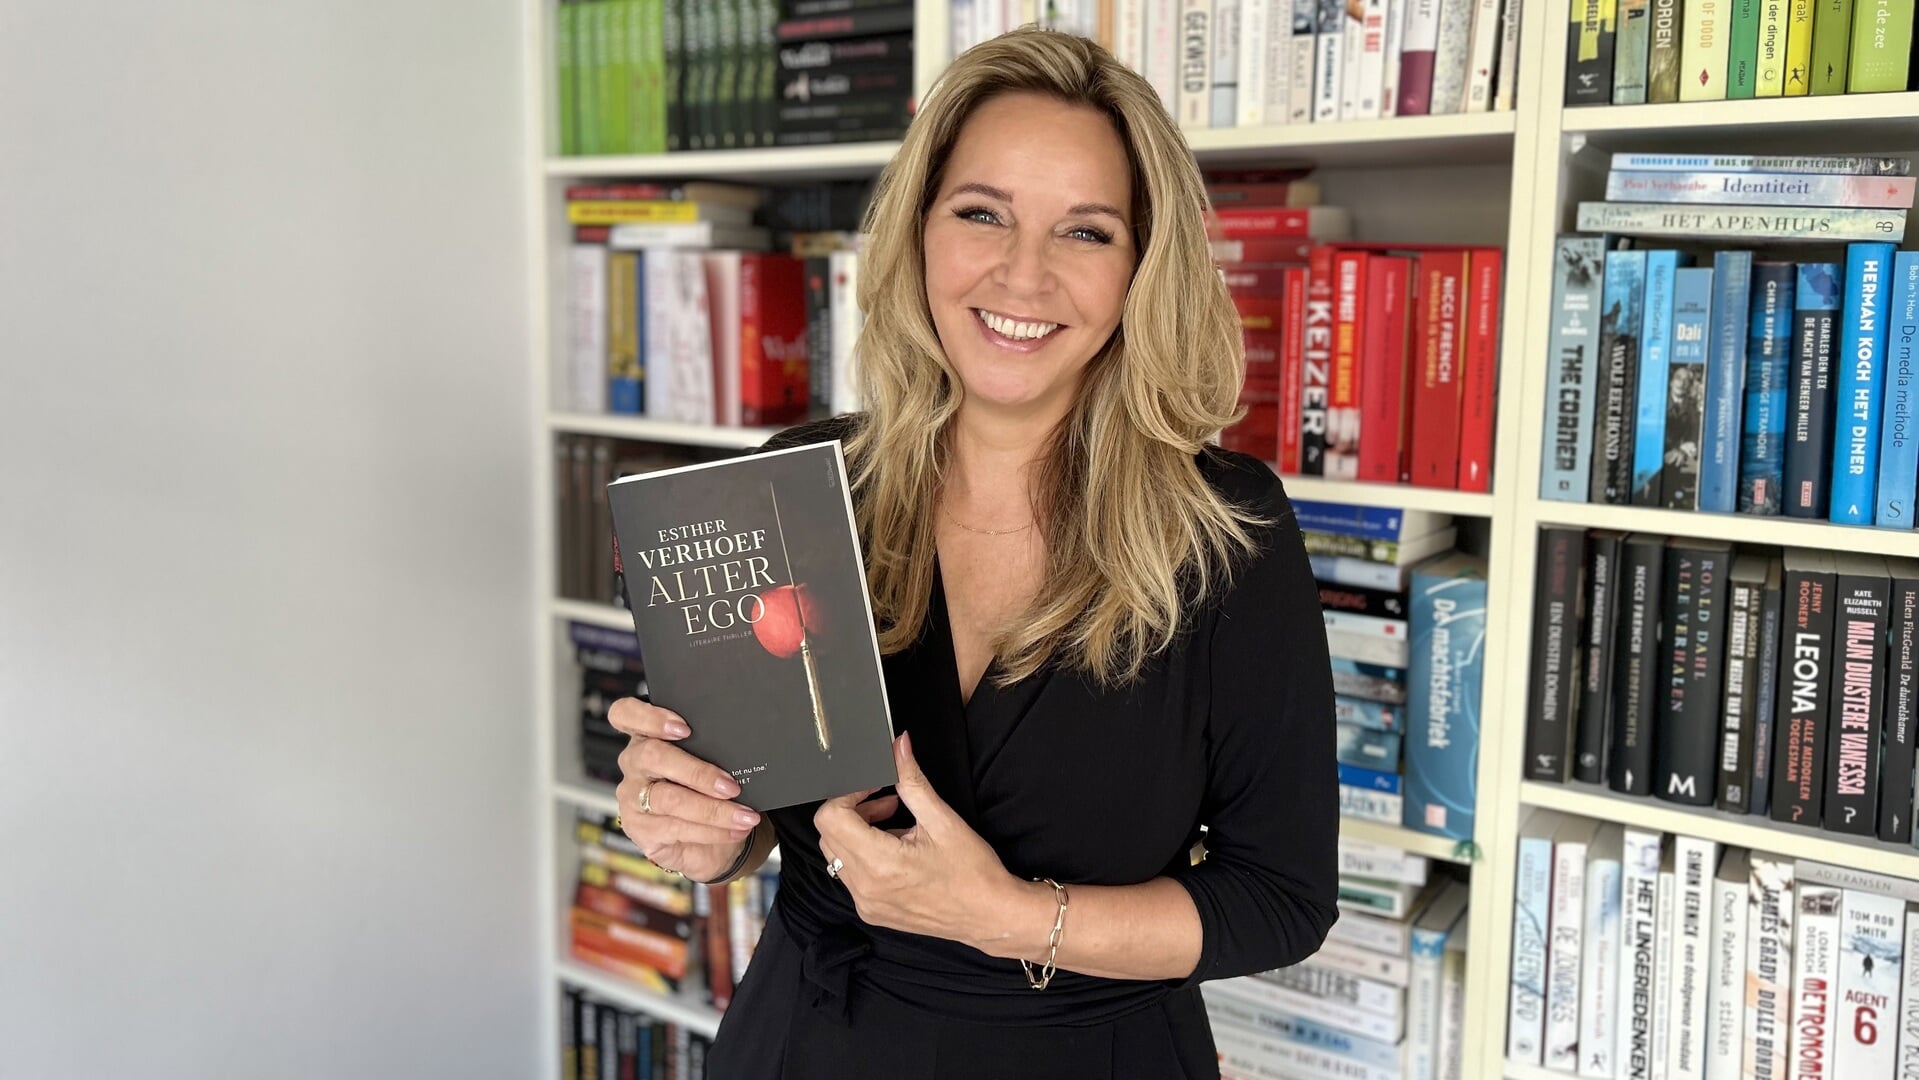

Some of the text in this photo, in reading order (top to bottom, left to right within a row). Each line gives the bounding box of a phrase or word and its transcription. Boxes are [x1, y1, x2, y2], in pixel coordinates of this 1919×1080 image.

[1764, 4, 1779, 60] der dingen
[1874, 9, 1891, 49] de zee
[1184, 11, 1208, 94] GEKWELD
[1722, 178, 1811, 194] Identiteit
[1661, 213, 1832, 233] HET APENHUIS
[1907, 282, 1916, 291] in
[1908, 264, 1919, 281] Bob
[1765, 281, 1777, 315] CHRIS
[1905, 299, 1917, 321] Hout
[1438, 276, 1455, 383] NICCI FRENCH
[1900, 324, 1917, 344] De
[1302, 301, 1333, 436] KEIZER
[1561, 344, 1584, 385] THE
[1816, 317, 1832, 390] CHARLES DEN TEX
[1848, 260, 1879, 476] HERMAN KOCH HET DINER
[1897, 346, 1915, 387] media
[1797, 317, 1816, 442] DE MACHT VAN MENEER MILLER
[1555, 388, 1581, 472] CORNER
[1606, 416, 1621, 461] HOND
[1757, 407, 1769, 459] STRANDEN
[1892, 390, 1912, 449] methode
[637, 529, 766, 570] VERHOEF
[657, 519, 728, 543] ESTHER
[647, 556, 777, 607] ALTER
[1633, 565, 1646, 602] NICCI
[1734, 587, 1749, 609] HET
[1811, 582, 1823, 614] JENNY
[1853, 589, 1873, 598] KATE
[680, 593, 765, 636] EGO
[1694, 560, 1714, 681] ROALD DAHL
[1798, 580, 1811, 629] ROGNEBY
[1843, 598, 1882, 608] ELIZABETH
[1846, 606, 1878, 616] RUSSELL
[689, 630, 753, 648] LITERAIRE THRILLER
[1630, 603, 1644, 654] FRENCH
[1428, 598, 1456, 749] De machtsfabriek
[1670, 612, 1689, 712] VERHALEN
[1790, 631, 1821, 714] LEONA
[1896, 591, 1917, 744] Helen FitzGerald De duivelskamer
[1836, 620, 1876, 795] MIJN DUISTERE VANESSA
[1786, 718, 1801, 782] TOEGESTAAN
[1799, 718, 1815, 800] ALLE MIDDELEN
[731, 769, 742, 777] tot
[1667, 771, 1696, 798] M
[1685, 849, 1703, 887] SIMON
[1815, 869, 1892, 891] AD FRANSEN
[1637, 878, 1654, 918] HET
[1761, 885, 1780, 934] JAMES
[1849, 909, 1895, 927] TOM ROB
[1804, 925, 1817, 974] DEUTSCH
[1855, 925, 1888, 939] SMITH
[1717, 891, 1738, 1057] Chuck Palahniuk stikken
[1758, 936, 1778, 985] GRADY
[1756, 988, 1776, 1036] DOLLE
[1844, 989, 1889, 1010] AGENT
[1853, 1005, 1878, 1047] 6
